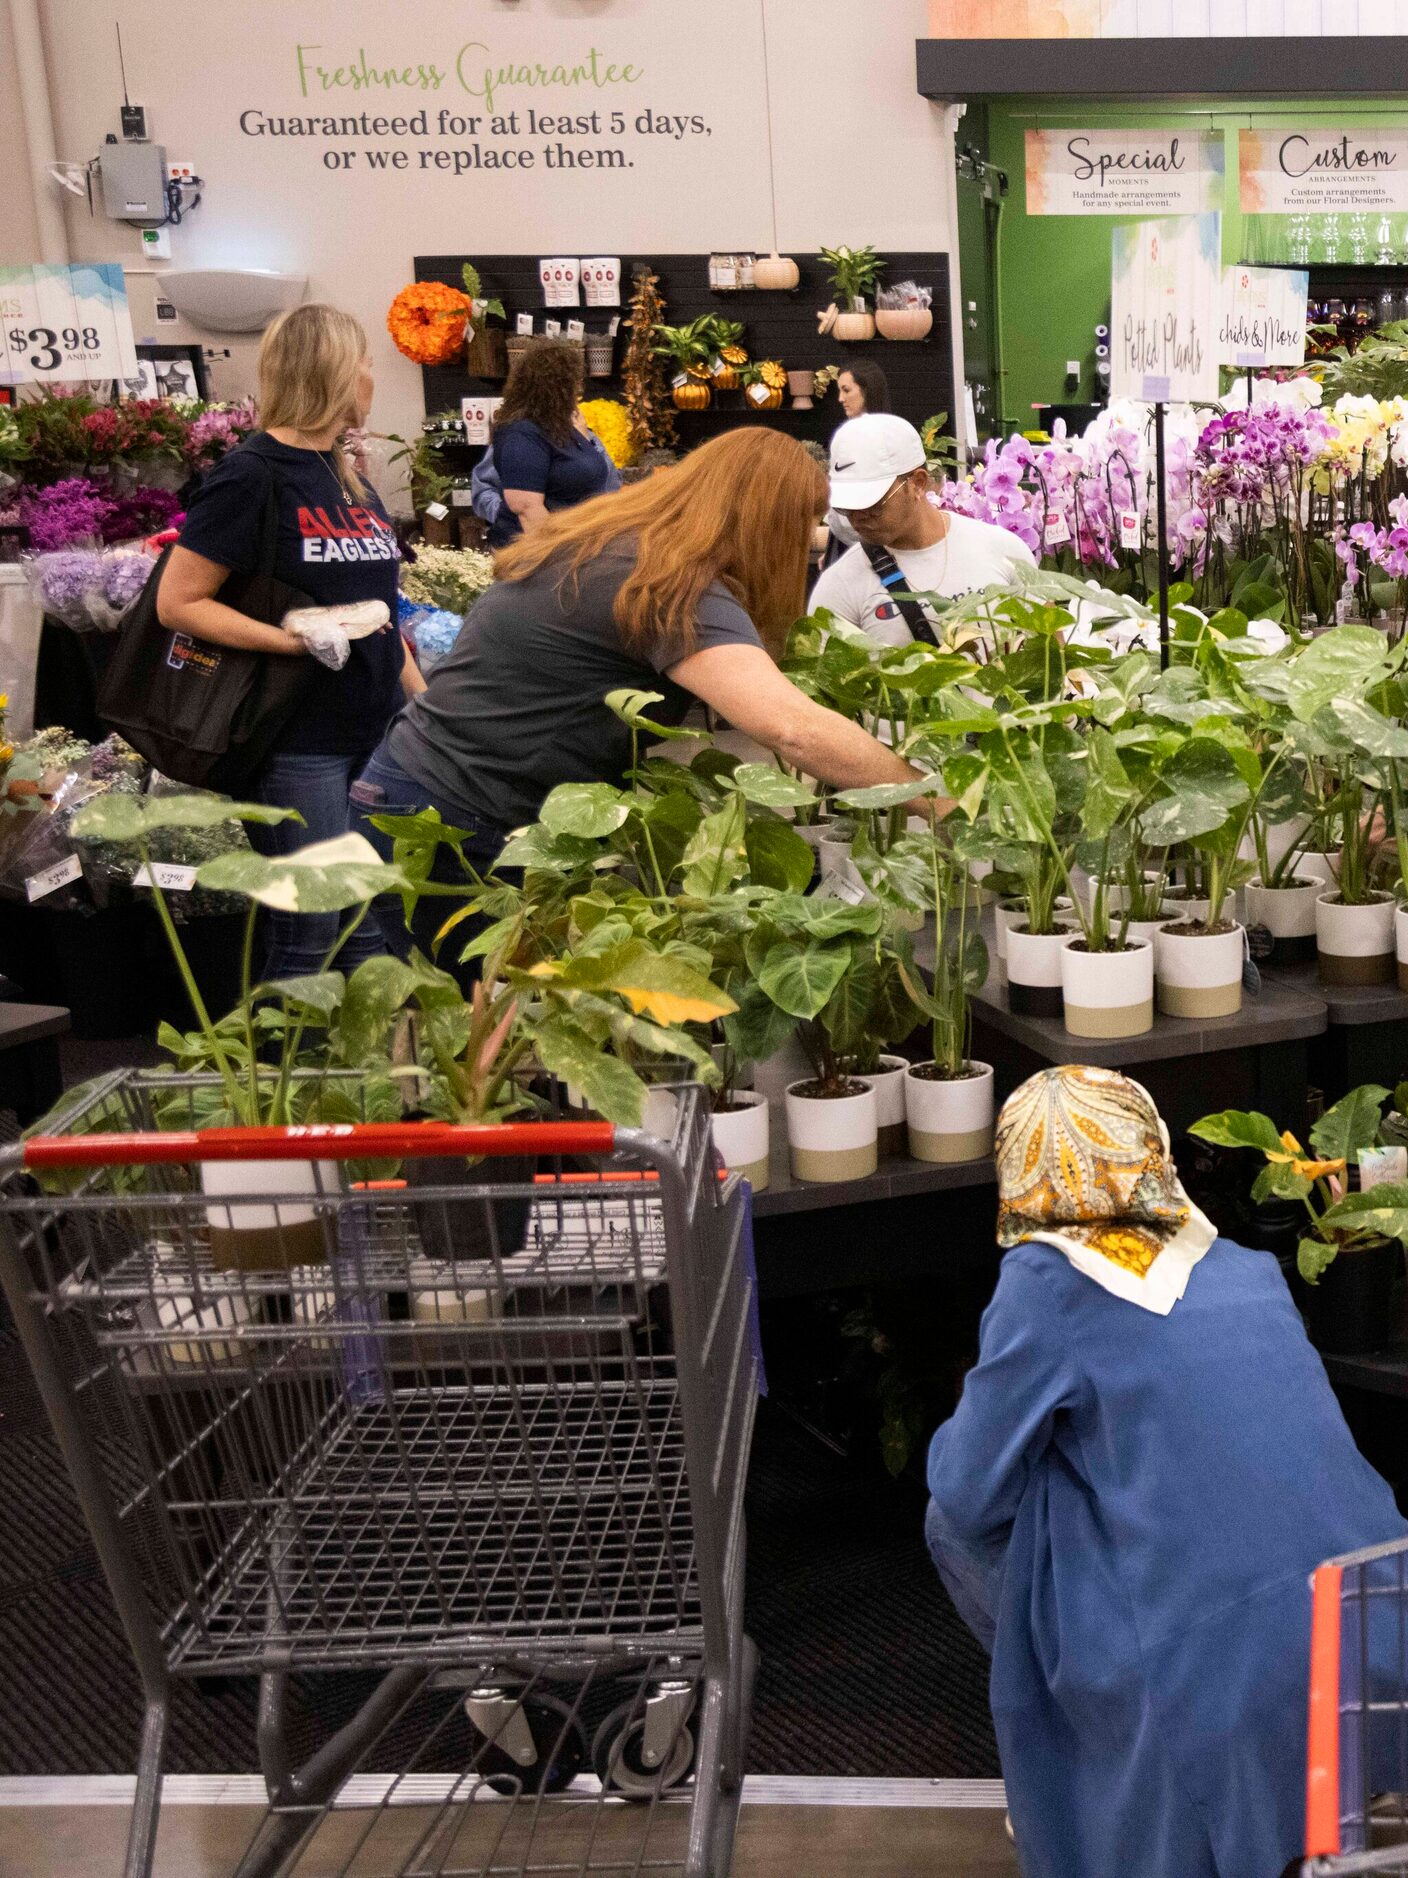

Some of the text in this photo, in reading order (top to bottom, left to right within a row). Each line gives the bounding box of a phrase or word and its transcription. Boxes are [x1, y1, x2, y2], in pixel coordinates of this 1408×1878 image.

[296, 42, 644, 113] Freshness Guarantee
[239, 108, 712, 140] Guaranteed for at least 5 days,
[323, 142, 635, 175] or we replace them.
[1067, 137, 1186, 187] Special
[1278, 134, 1397, 178] Custom
[1108, 178, 1150, 186] MOMENTS
[1291, 188, 1386, 197] Custom arrangements
[1309, 175, 1377, 183] ARRANGEMENTS
[1072, 191, 1182, 200] Handmade arrangements
[1082, 199, 1096, 207] for
[1097, 200, 1113, 208] any
[1114, 199, 1144, 208] special
[1283, 197, 1305, 205] from
[1323, 196, 1349, 205] Floral
[1122, 311, 1204, 376] Potted Plants
[1219, 313, 1249, 346] chids
[1263, 315, 1302, 353] More
[303, 536, 392, 563] EAGLES
